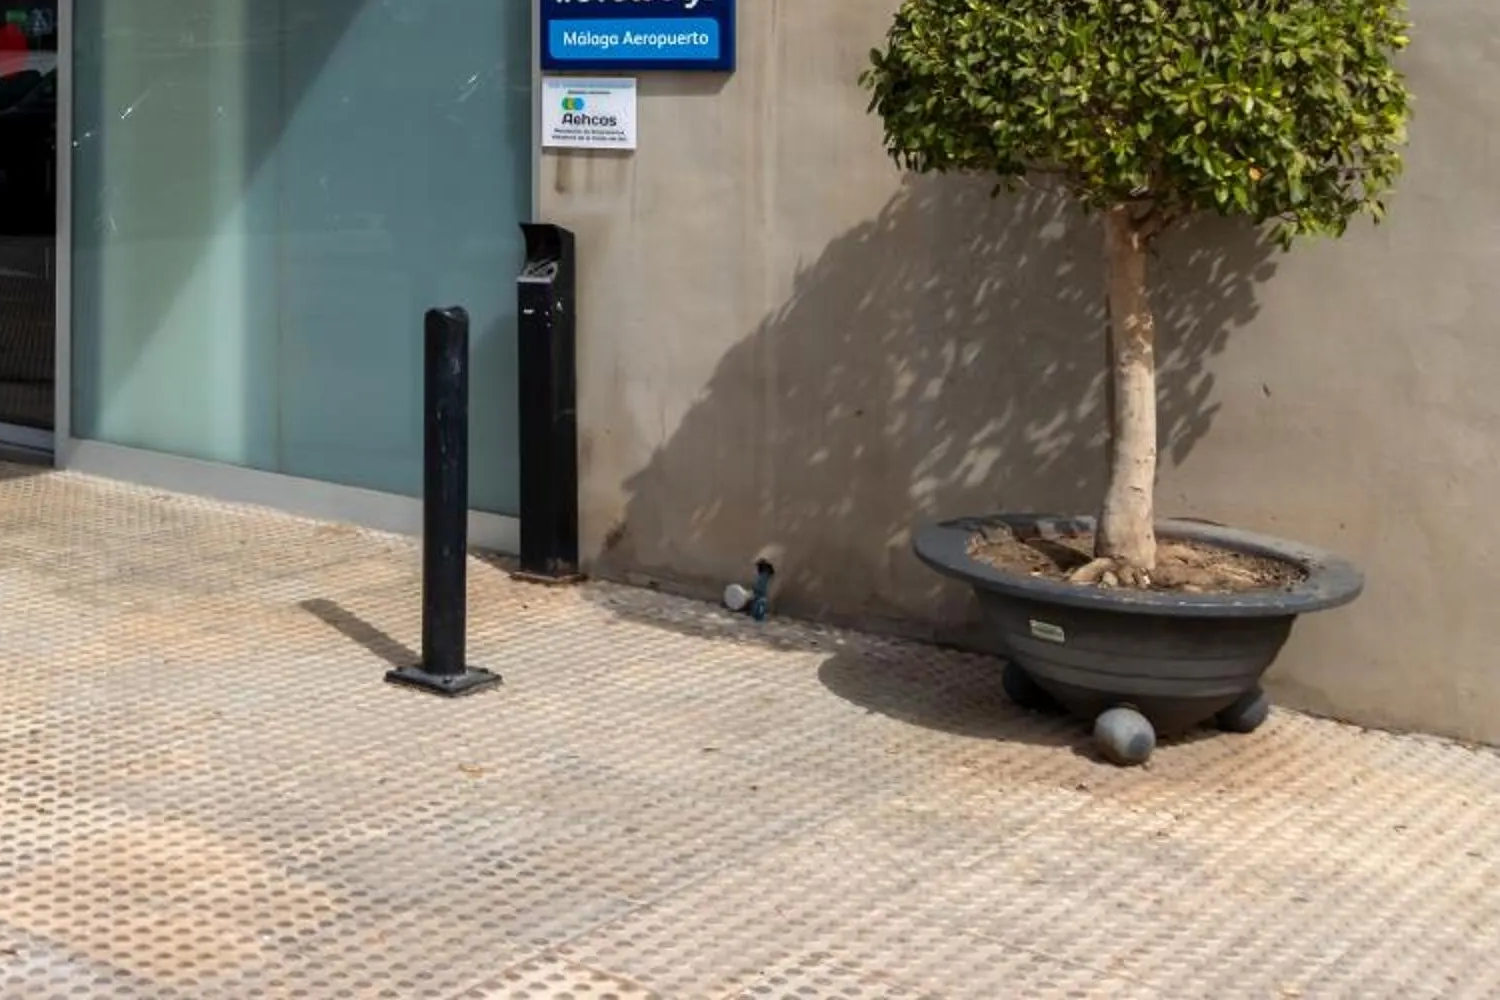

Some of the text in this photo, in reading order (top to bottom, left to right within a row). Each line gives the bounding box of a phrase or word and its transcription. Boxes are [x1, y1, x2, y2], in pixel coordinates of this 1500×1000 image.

[563, 30, 709, 49] Málaga Aeropuerto
[561, 112, 617, 127] Aehcos
